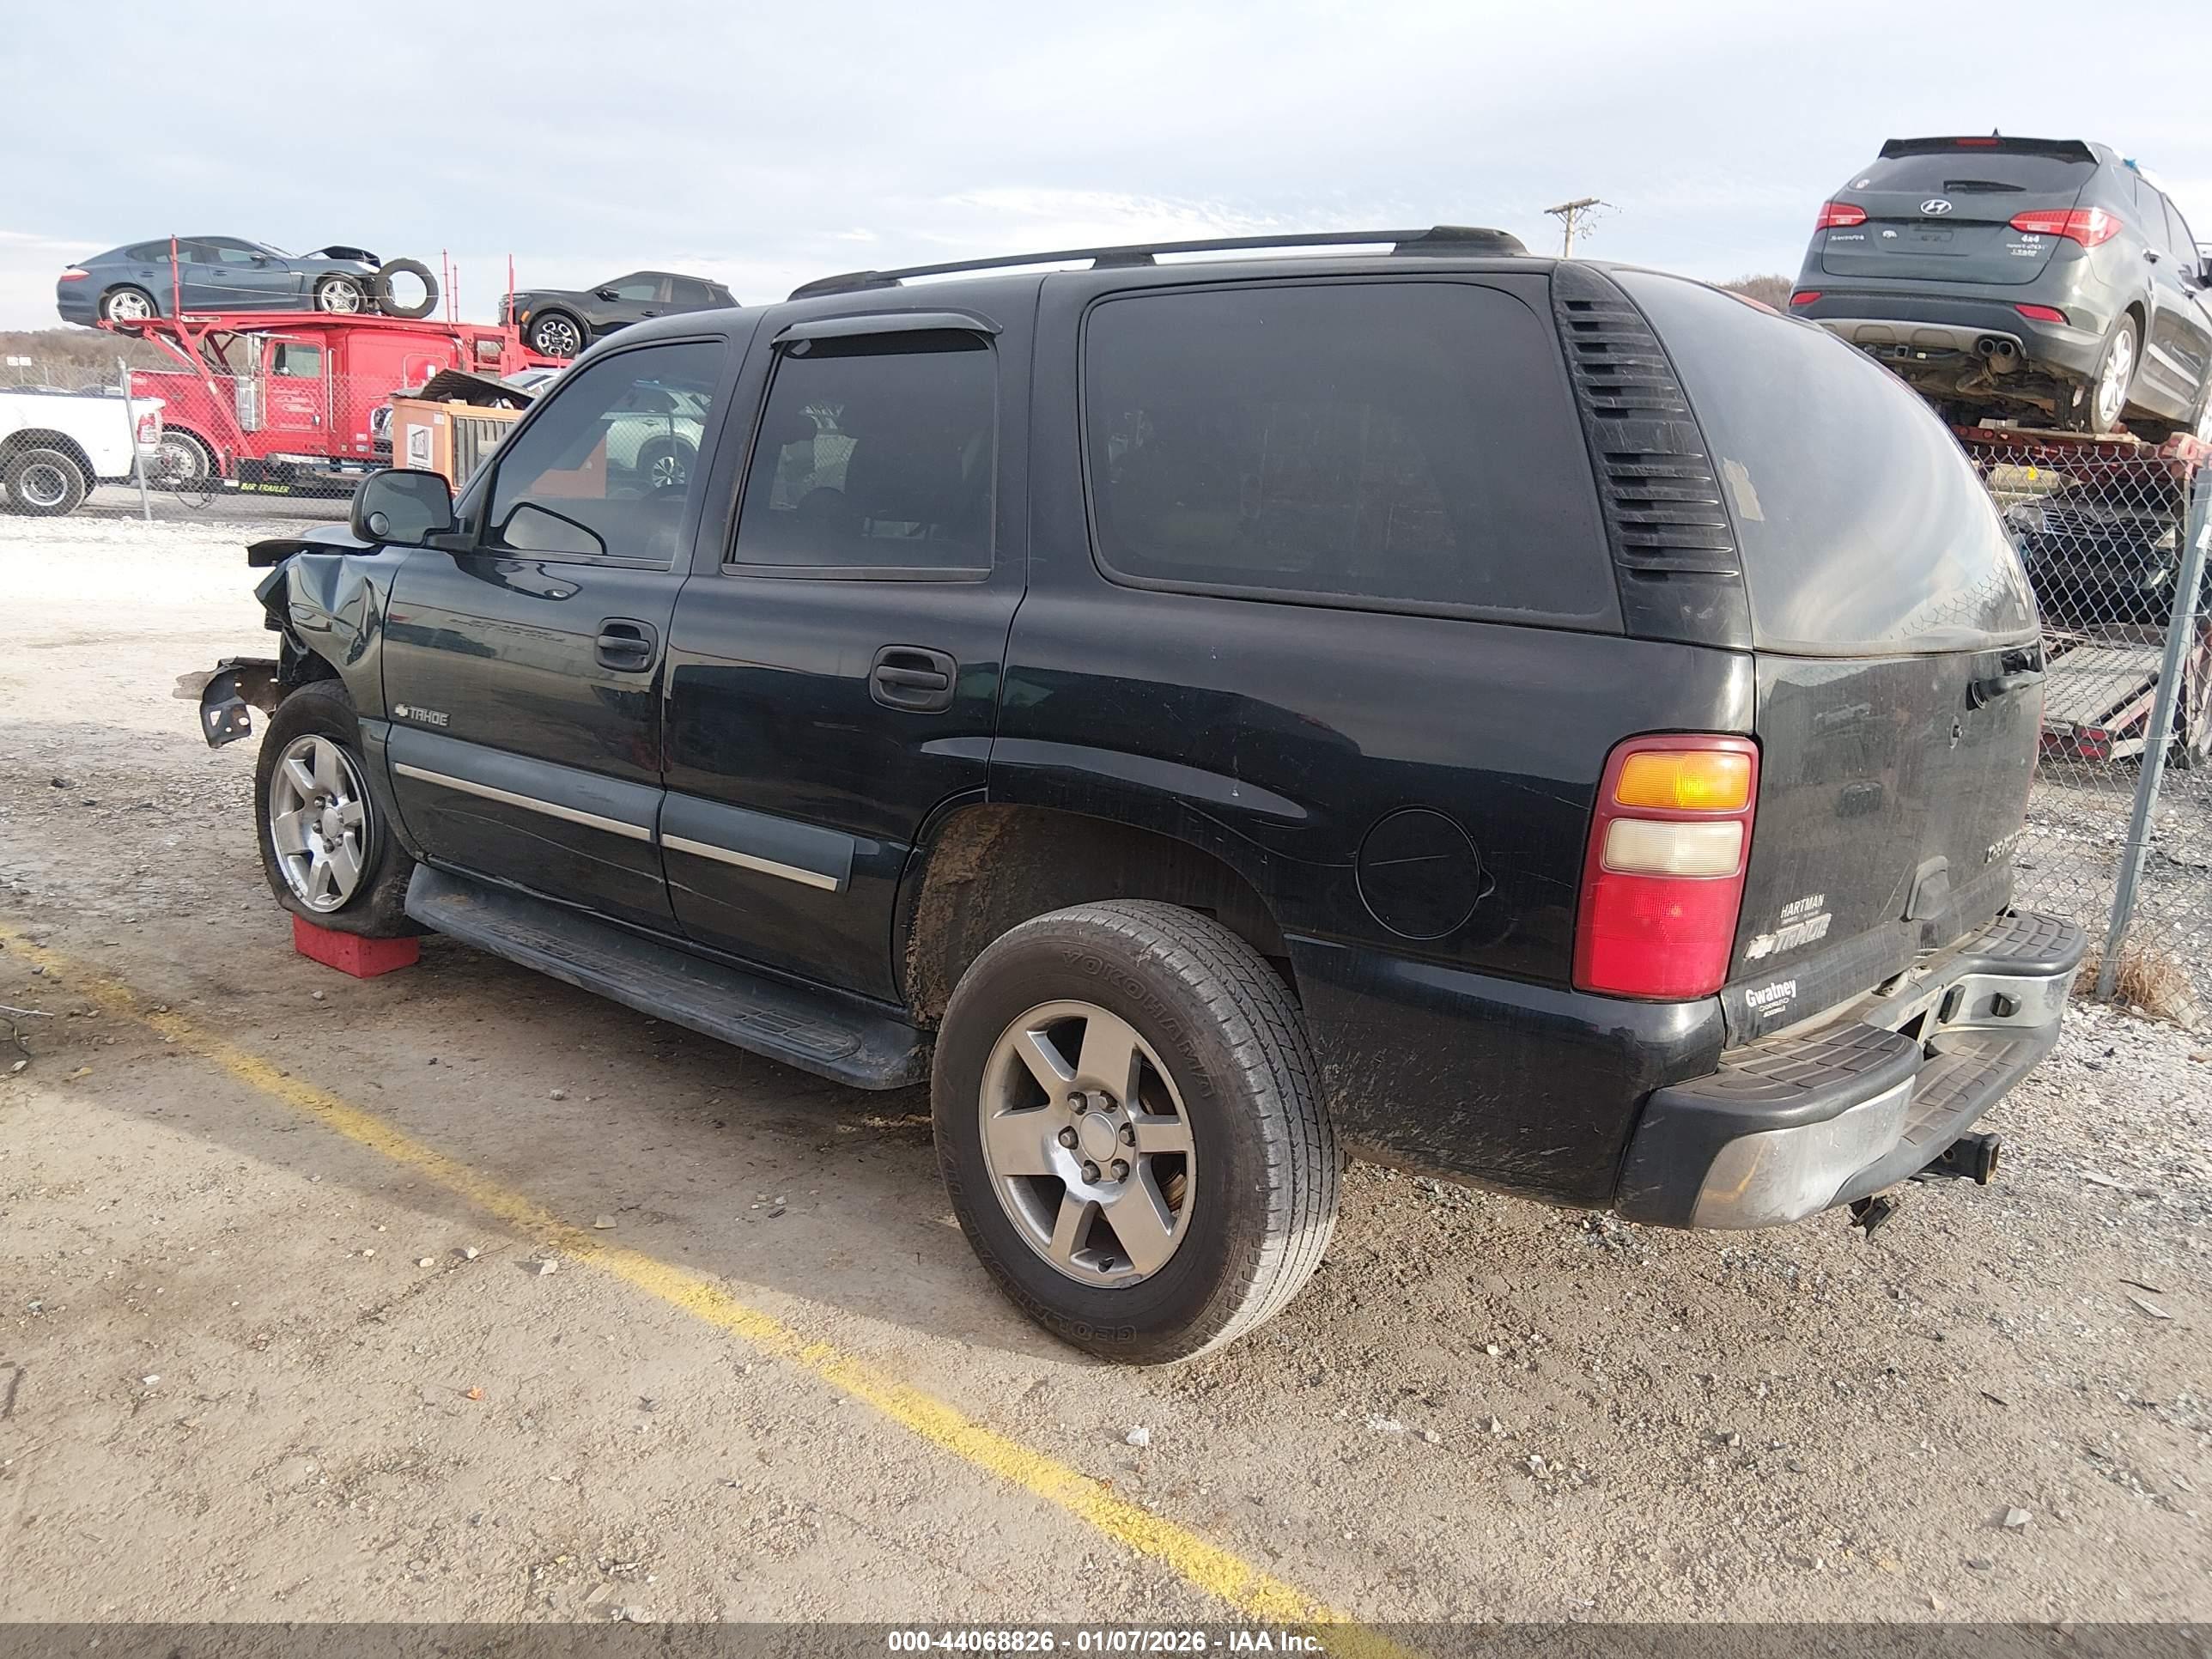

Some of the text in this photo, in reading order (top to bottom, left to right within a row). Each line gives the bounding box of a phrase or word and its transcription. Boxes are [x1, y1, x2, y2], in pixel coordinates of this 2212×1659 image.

[410, 706, 449, 726] TAHOE
[1780, 894, 1825, 919] HARTMAN
[1745, 979, 1796, 1007] Gwatney
[1062, 950, 1215, 1097] YOKOHAMA
